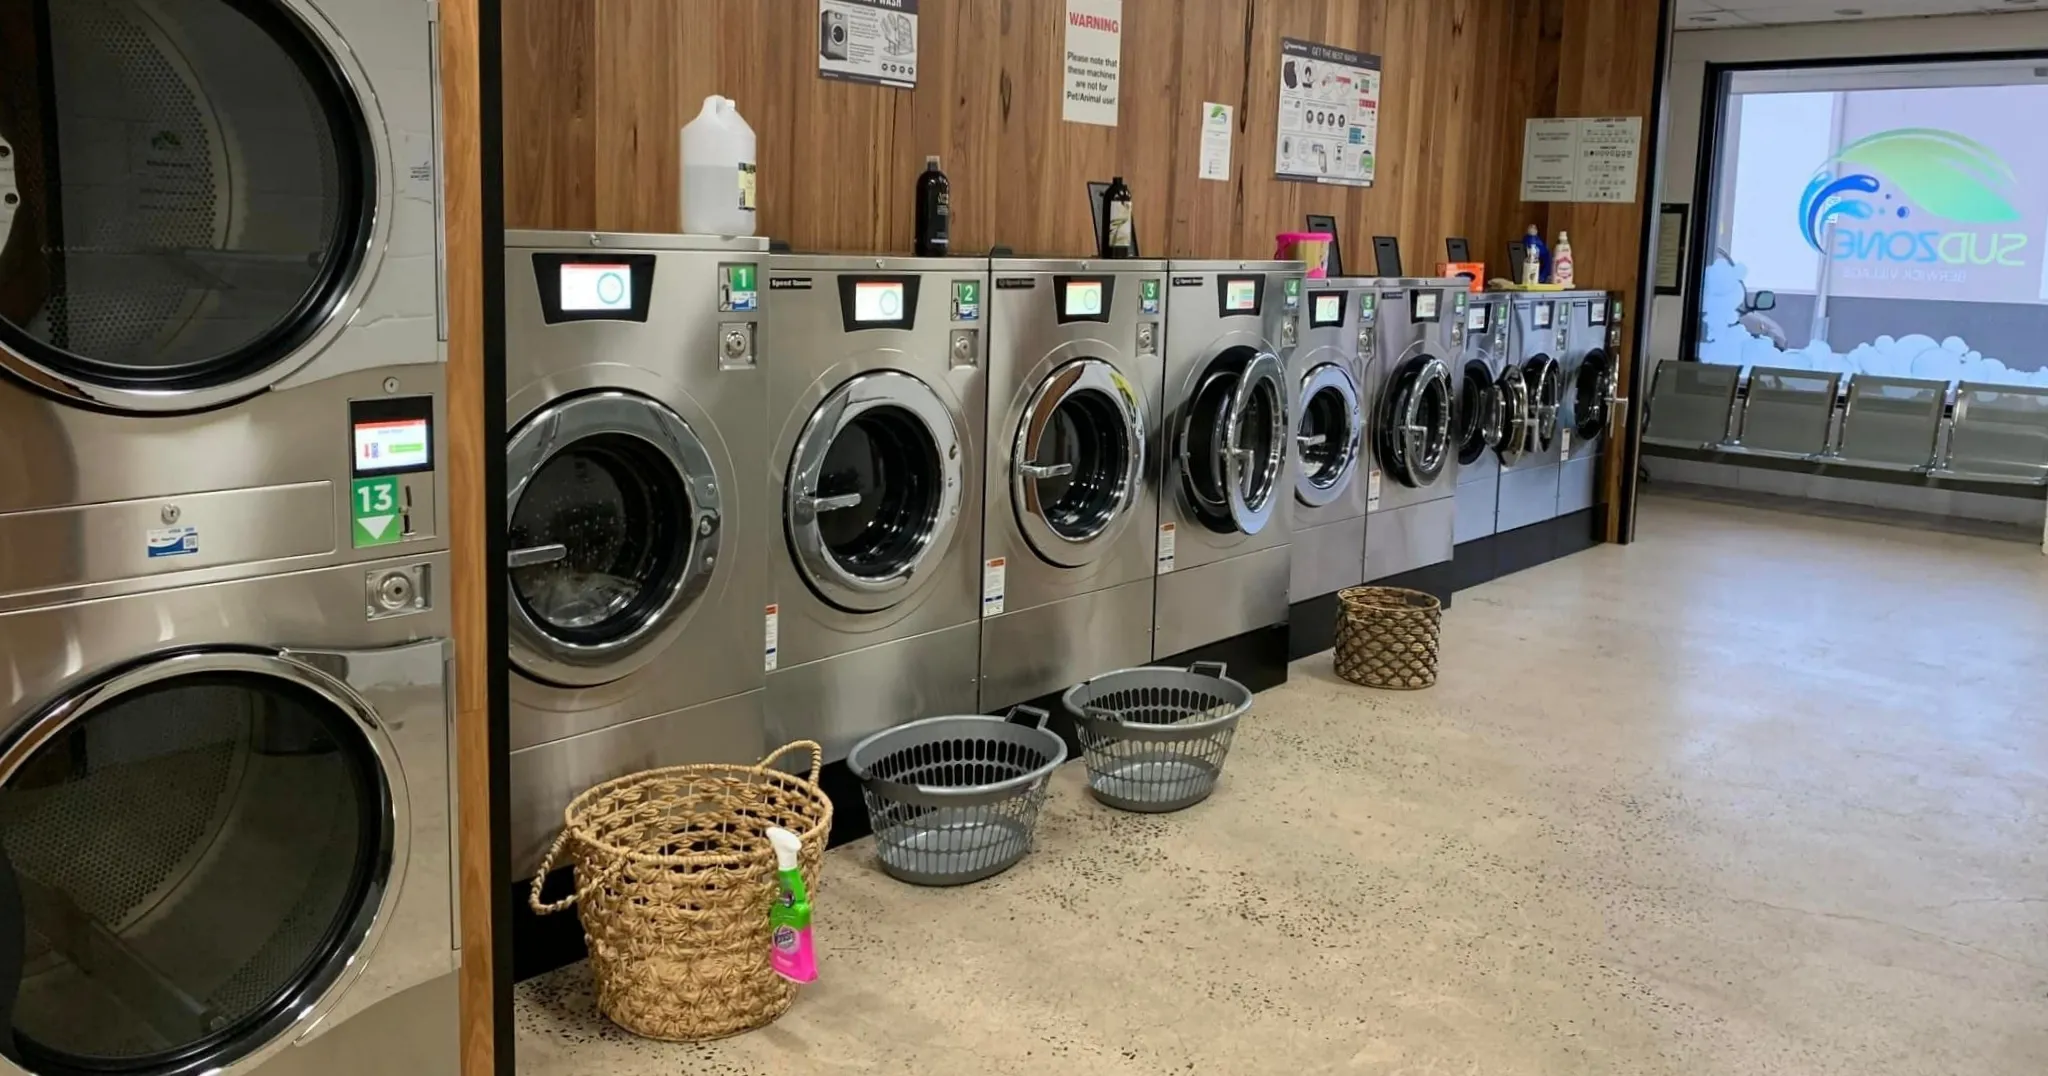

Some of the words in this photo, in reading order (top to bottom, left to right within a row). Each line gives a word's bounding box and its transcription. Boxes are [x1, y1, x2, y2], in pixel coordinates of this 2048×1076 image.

[1069, 12, 1119, 33] WARNING
[1067, 51, 1089, 63] Please
[1090, 56, 1104, 65] note
[1105, 58, 1117, 68] that
[1311, 46, 1321, 56] GET
[1322, 48, 1332, 58] THE
[1332, 50, 1343, 60] BEST
[1067, 65, 1085, 75] these
[1087, 69, 1116, 80] machines
[1075, 80, 1086, 88] are
[1087, 81, 1098, 90] not
[1099, 82, 1108, 91] for
[1066, 91, 1101, 103] Pet/Animal
[738, 268, 747, 288] 1
[964, 285, 974, 301] 2
[1147, 282, 1154, 298] 3
[1289, 281, 1297, 294] 4
[357, 483, 393, 513] 13
